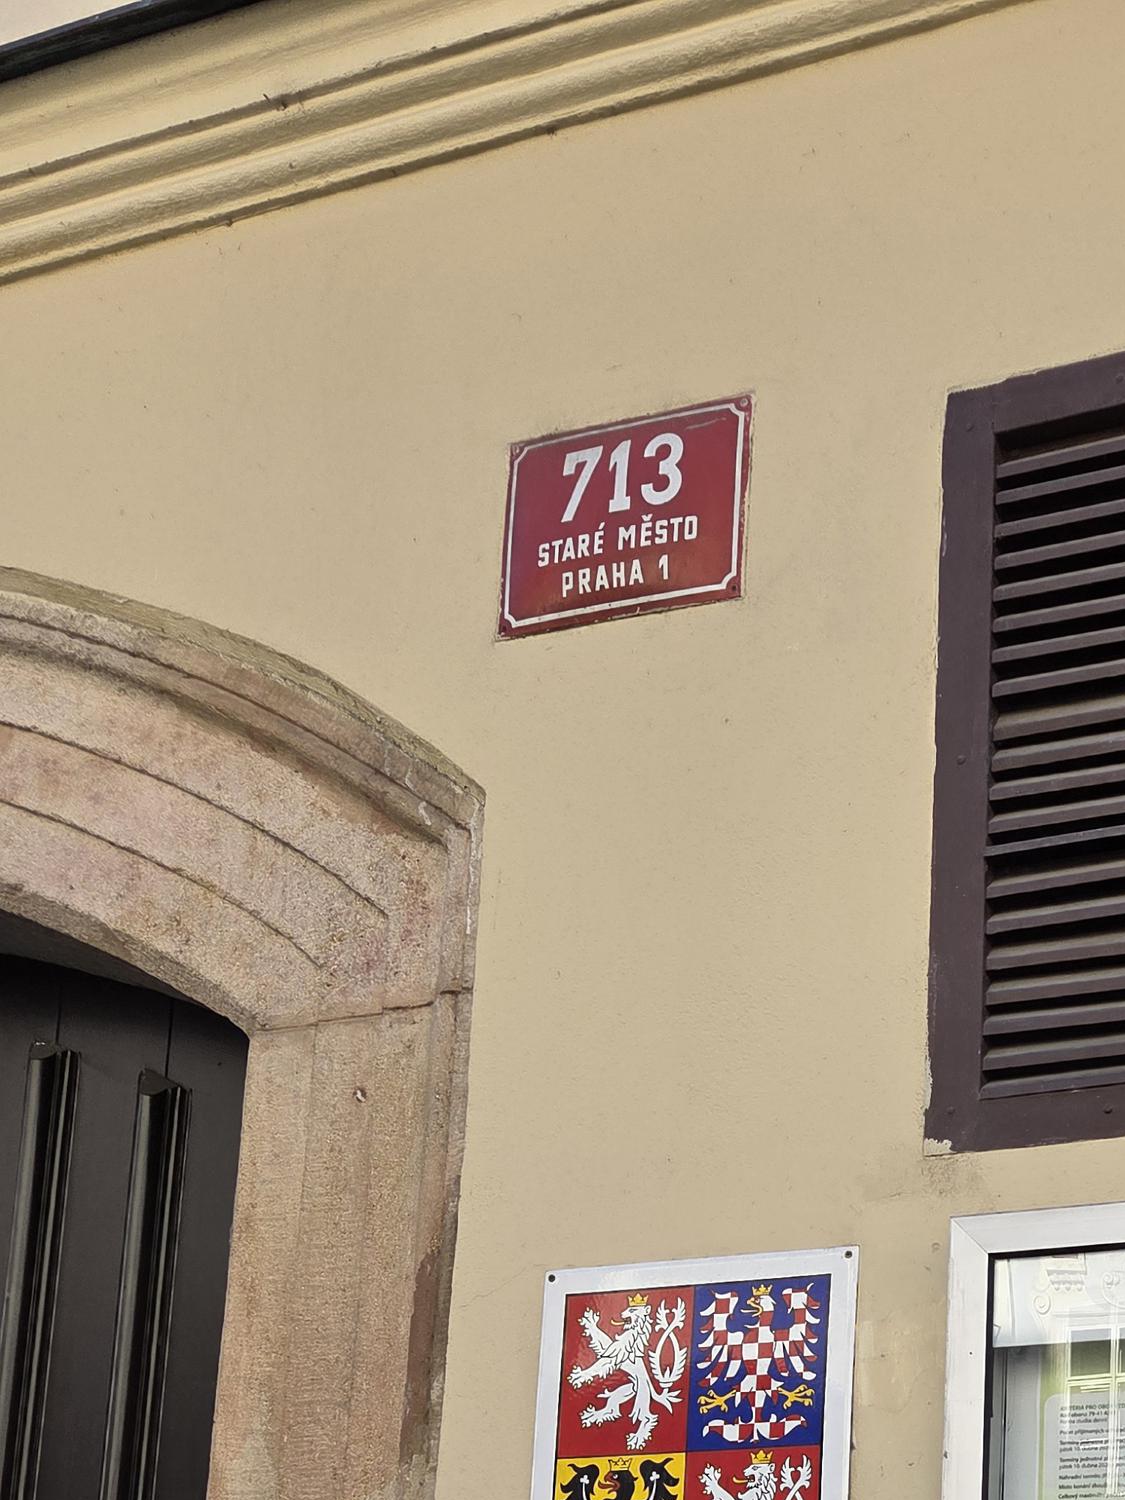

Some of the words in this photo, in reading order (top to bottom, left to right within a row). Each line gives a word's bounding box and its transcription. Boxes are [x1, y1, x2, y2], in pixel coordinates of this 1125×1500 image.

[561, 433, 683, 522] 713
[538, 522, 604, 567] STARÉ
[618, 514, 698, 550] MĚSTO
[562, 560, 643, 597] PRAHA
[659, 555, 668, 580] 1
